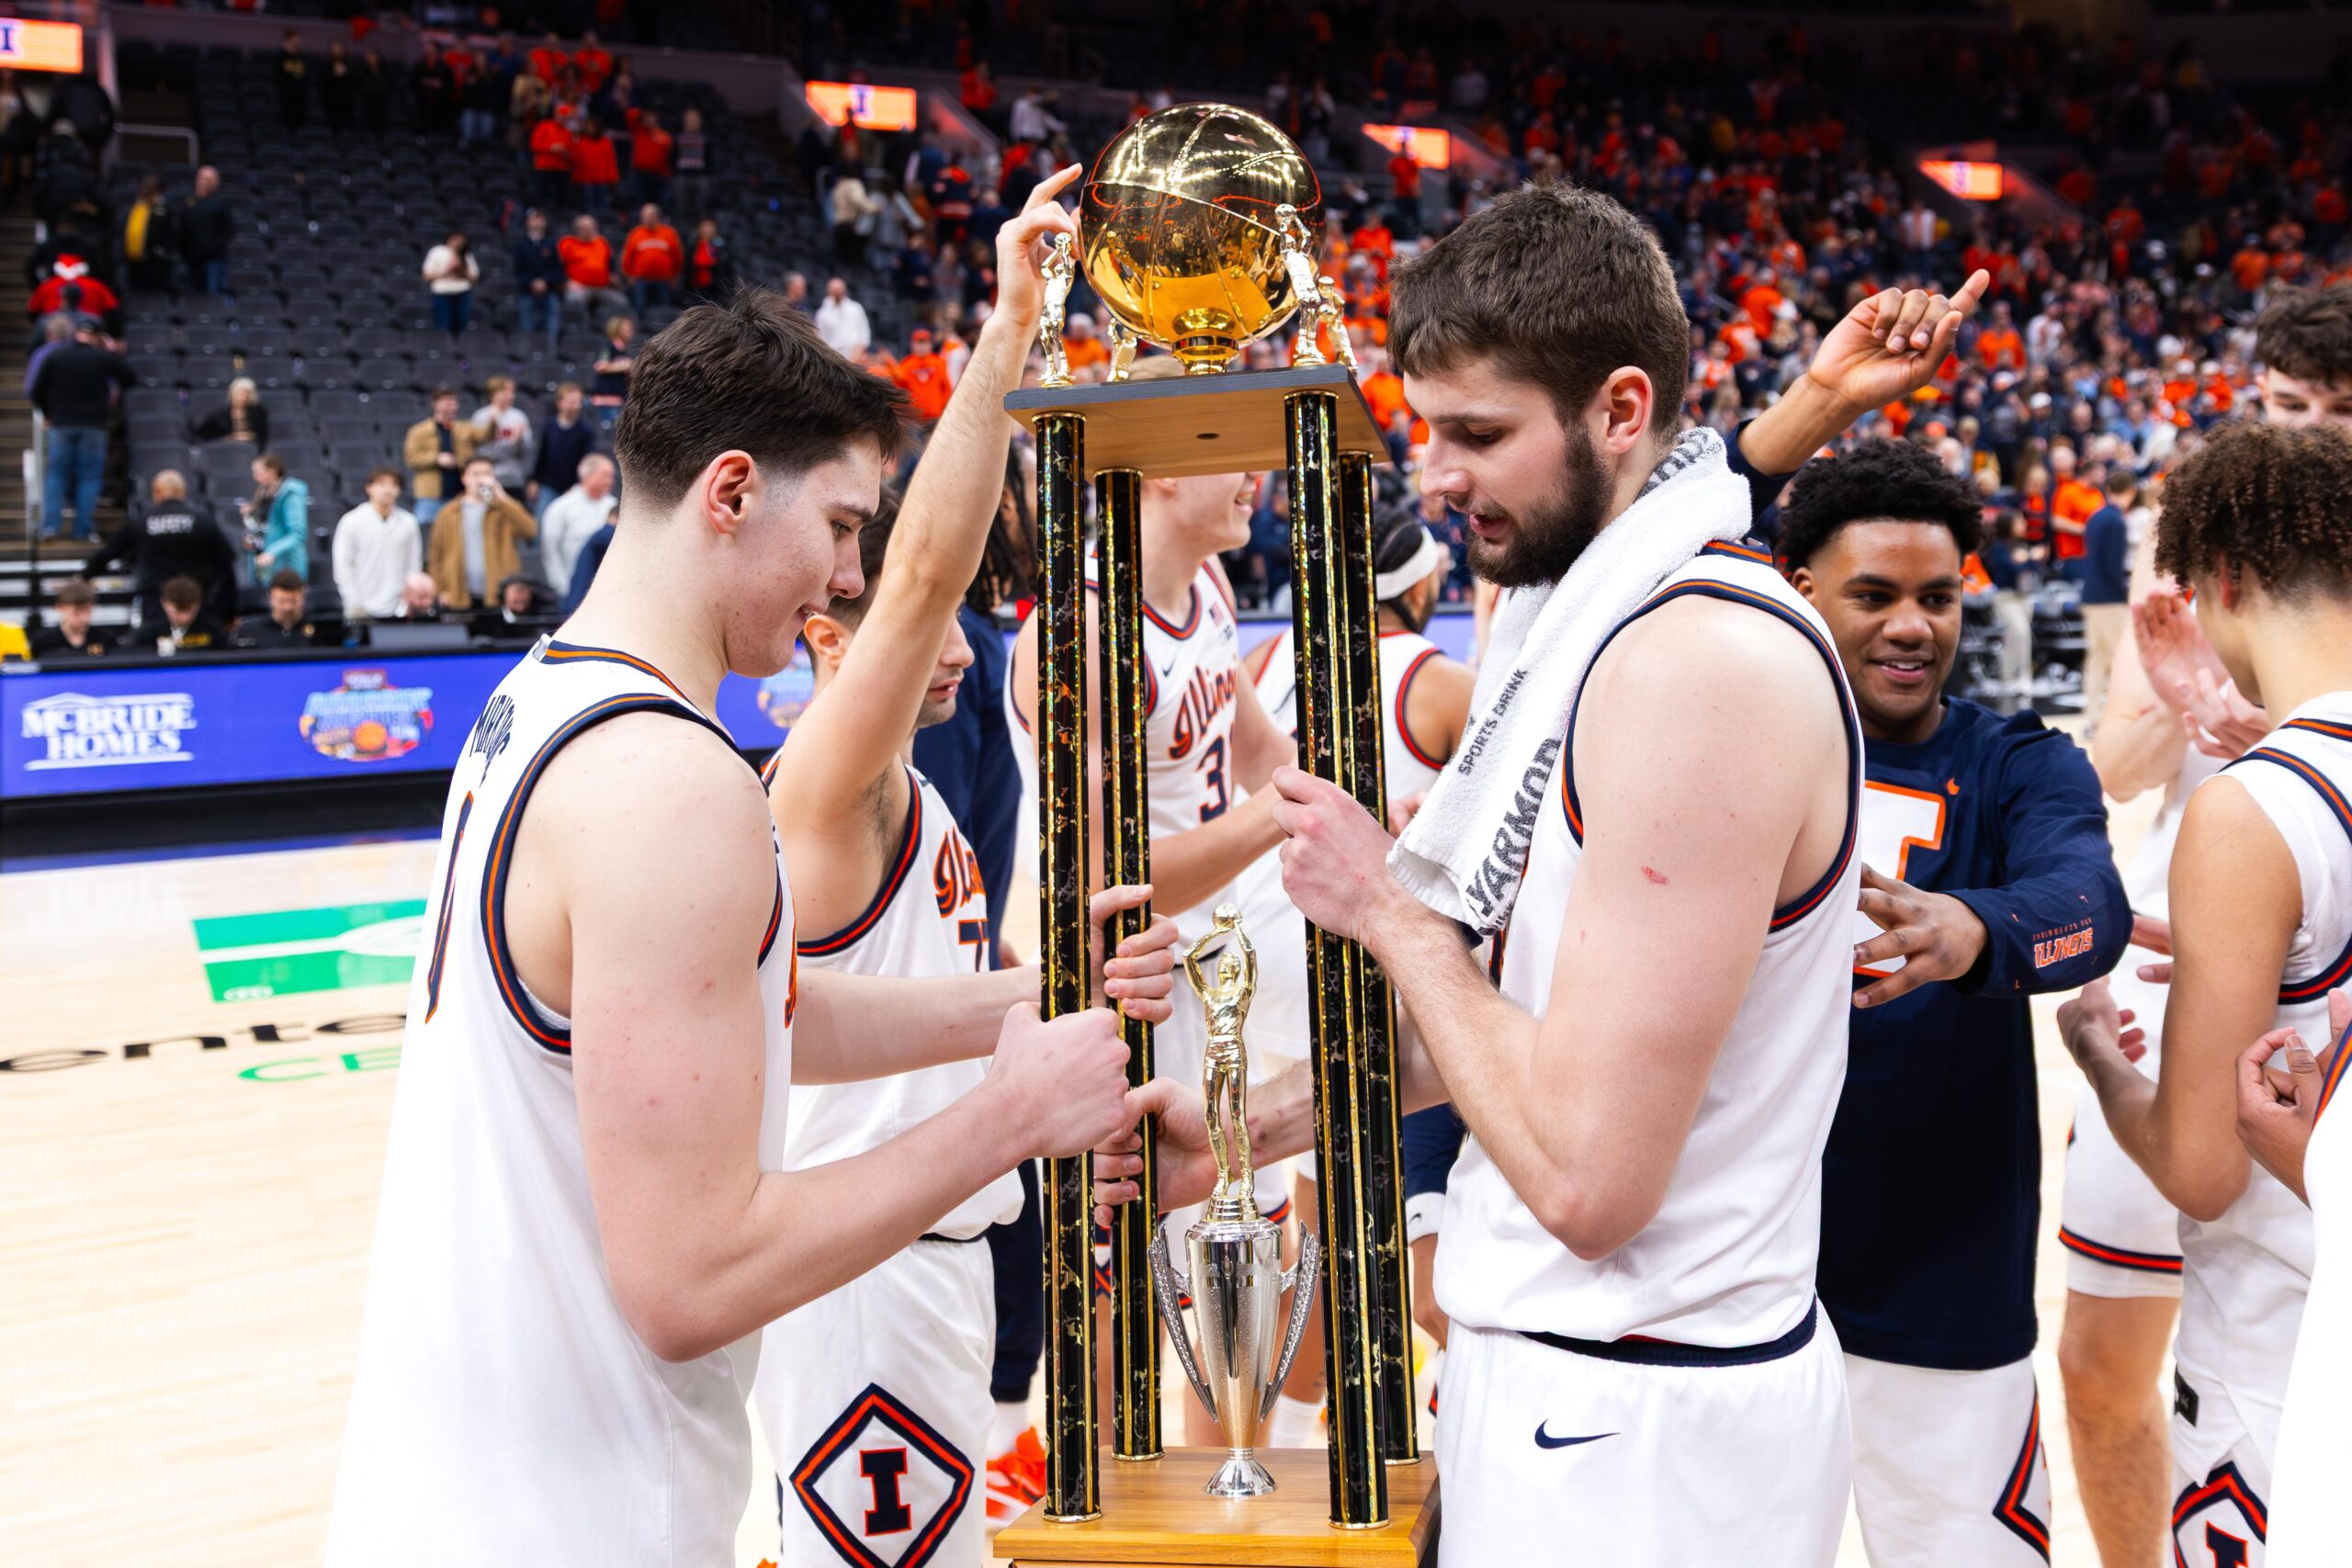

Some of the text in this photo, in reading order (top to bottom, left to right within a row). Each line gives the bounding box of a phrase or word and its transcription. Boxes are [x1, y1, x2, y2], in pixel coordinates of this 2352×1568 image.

[47, 729, 182, 761] HOMES
[1457, 668, 1528, 777] SPORTS DRINK
[1196, 723, 1235, 824] 3
[2034, 927, 2094, 968] ILLINOIS
[859, 1447, 912, 1538] I
